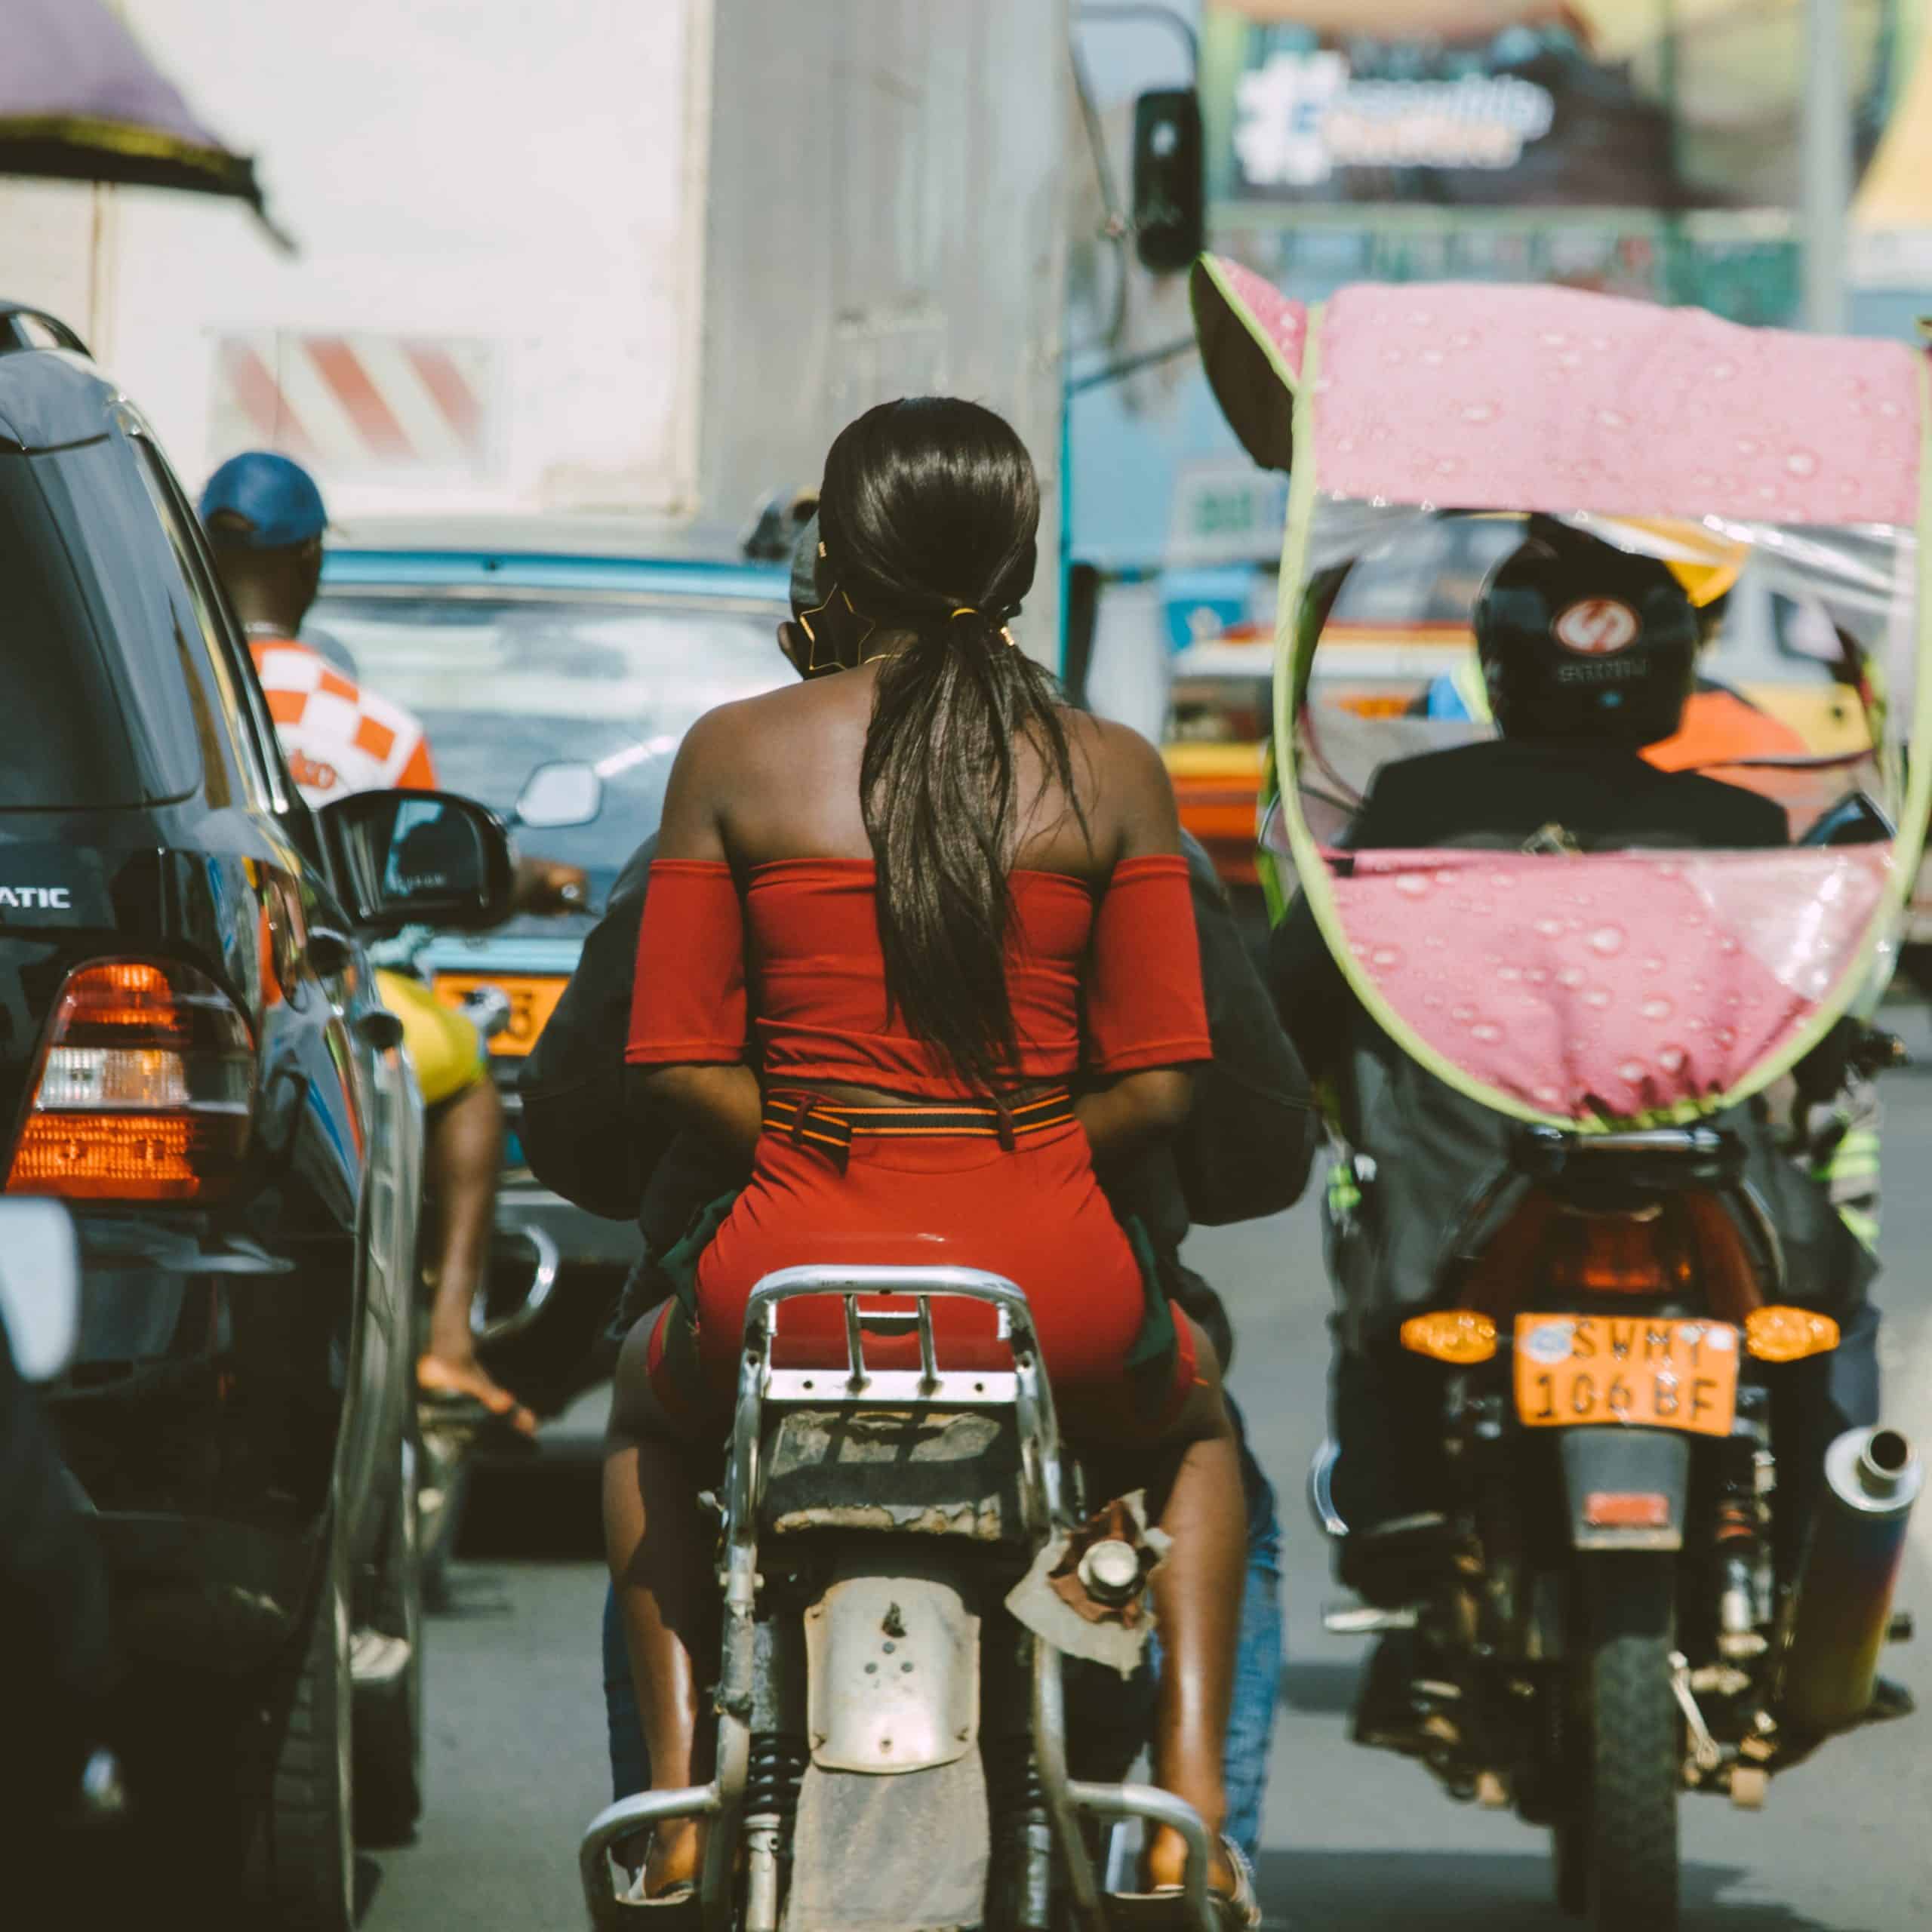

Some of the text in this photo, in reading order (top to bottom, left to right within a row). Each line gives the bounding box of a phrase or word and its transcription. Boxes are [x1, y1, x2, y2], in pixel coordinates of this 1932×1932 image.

[0, 886, 72, 909] ATIC
[1535, 1372, 1717, 1422] 106 BF
